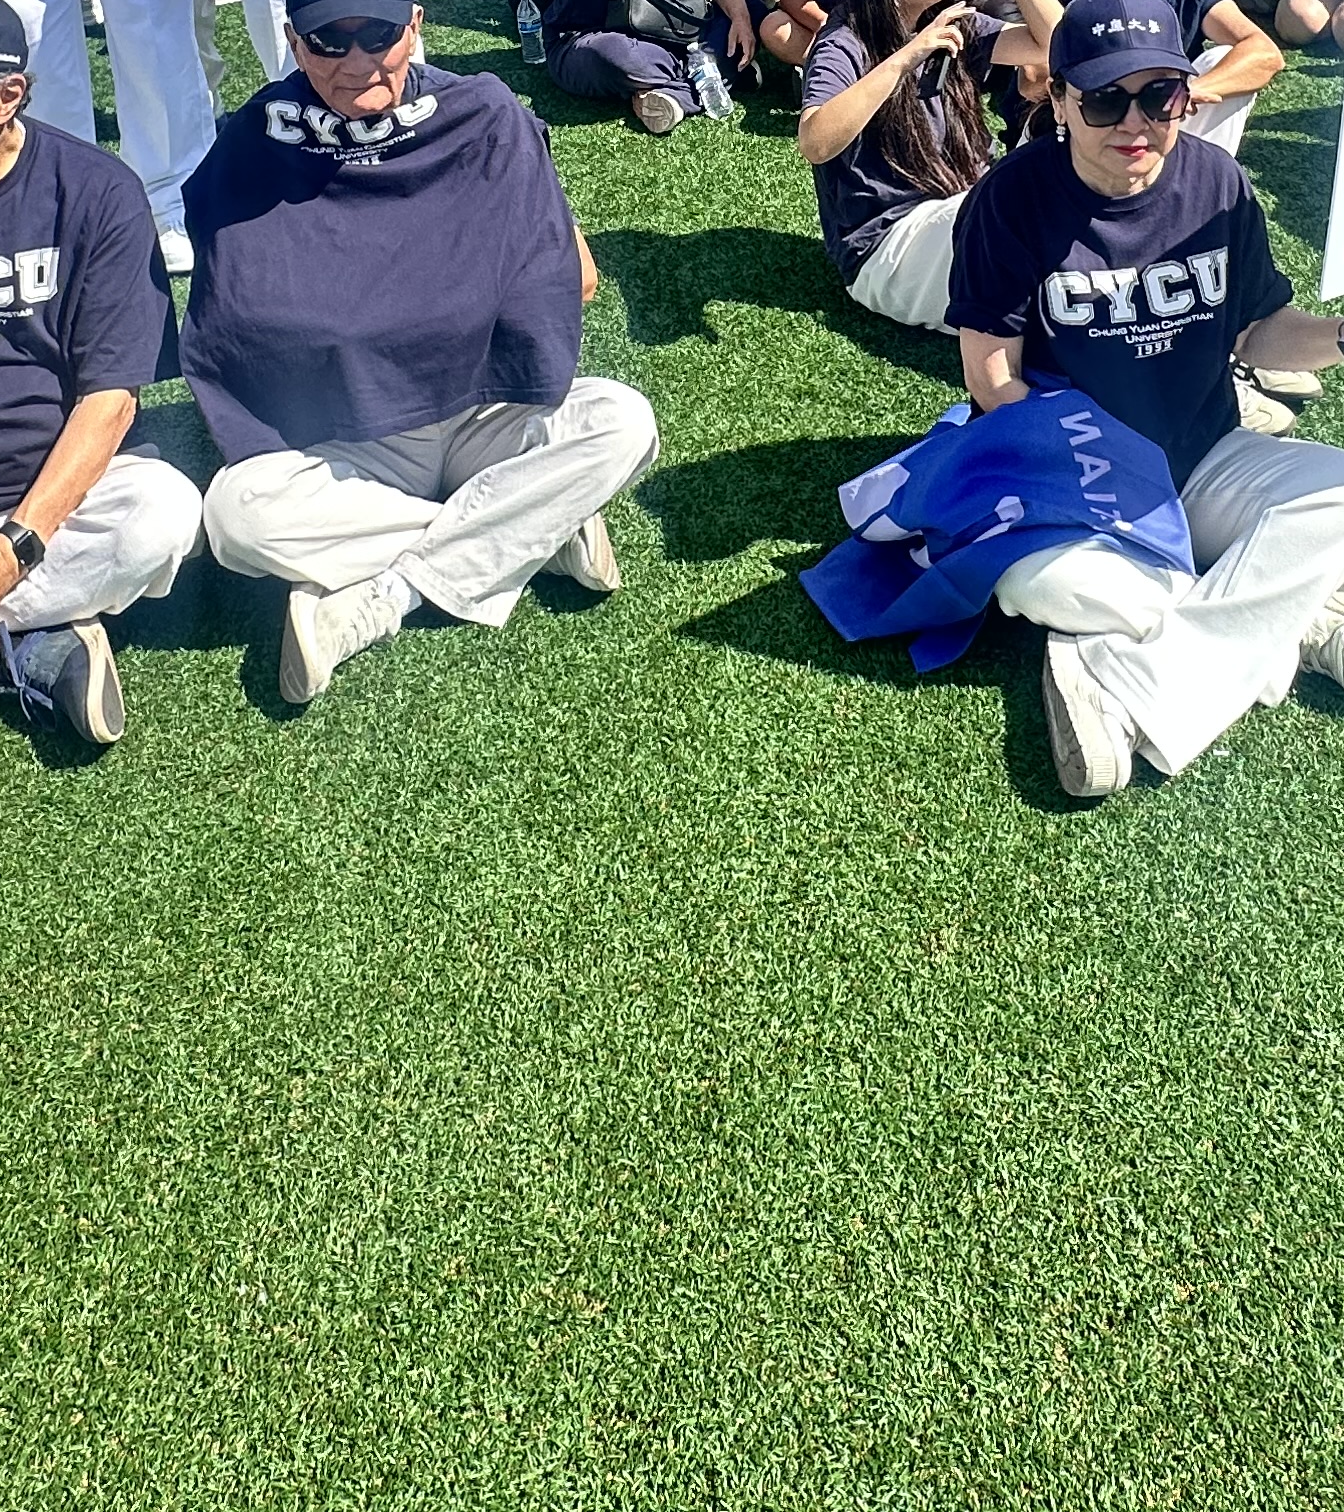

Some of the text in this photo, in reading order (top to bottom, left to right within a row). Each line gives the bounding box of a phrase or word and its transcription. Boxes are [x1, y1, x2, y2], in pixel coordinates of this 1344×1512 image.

[1044, 245, 1228, 326] CYCU
[1088, 312, 1214, 338] CHUNG YUAN CHRISTIAN
[1125, 326, 1184, 344] UNIVERSITY
